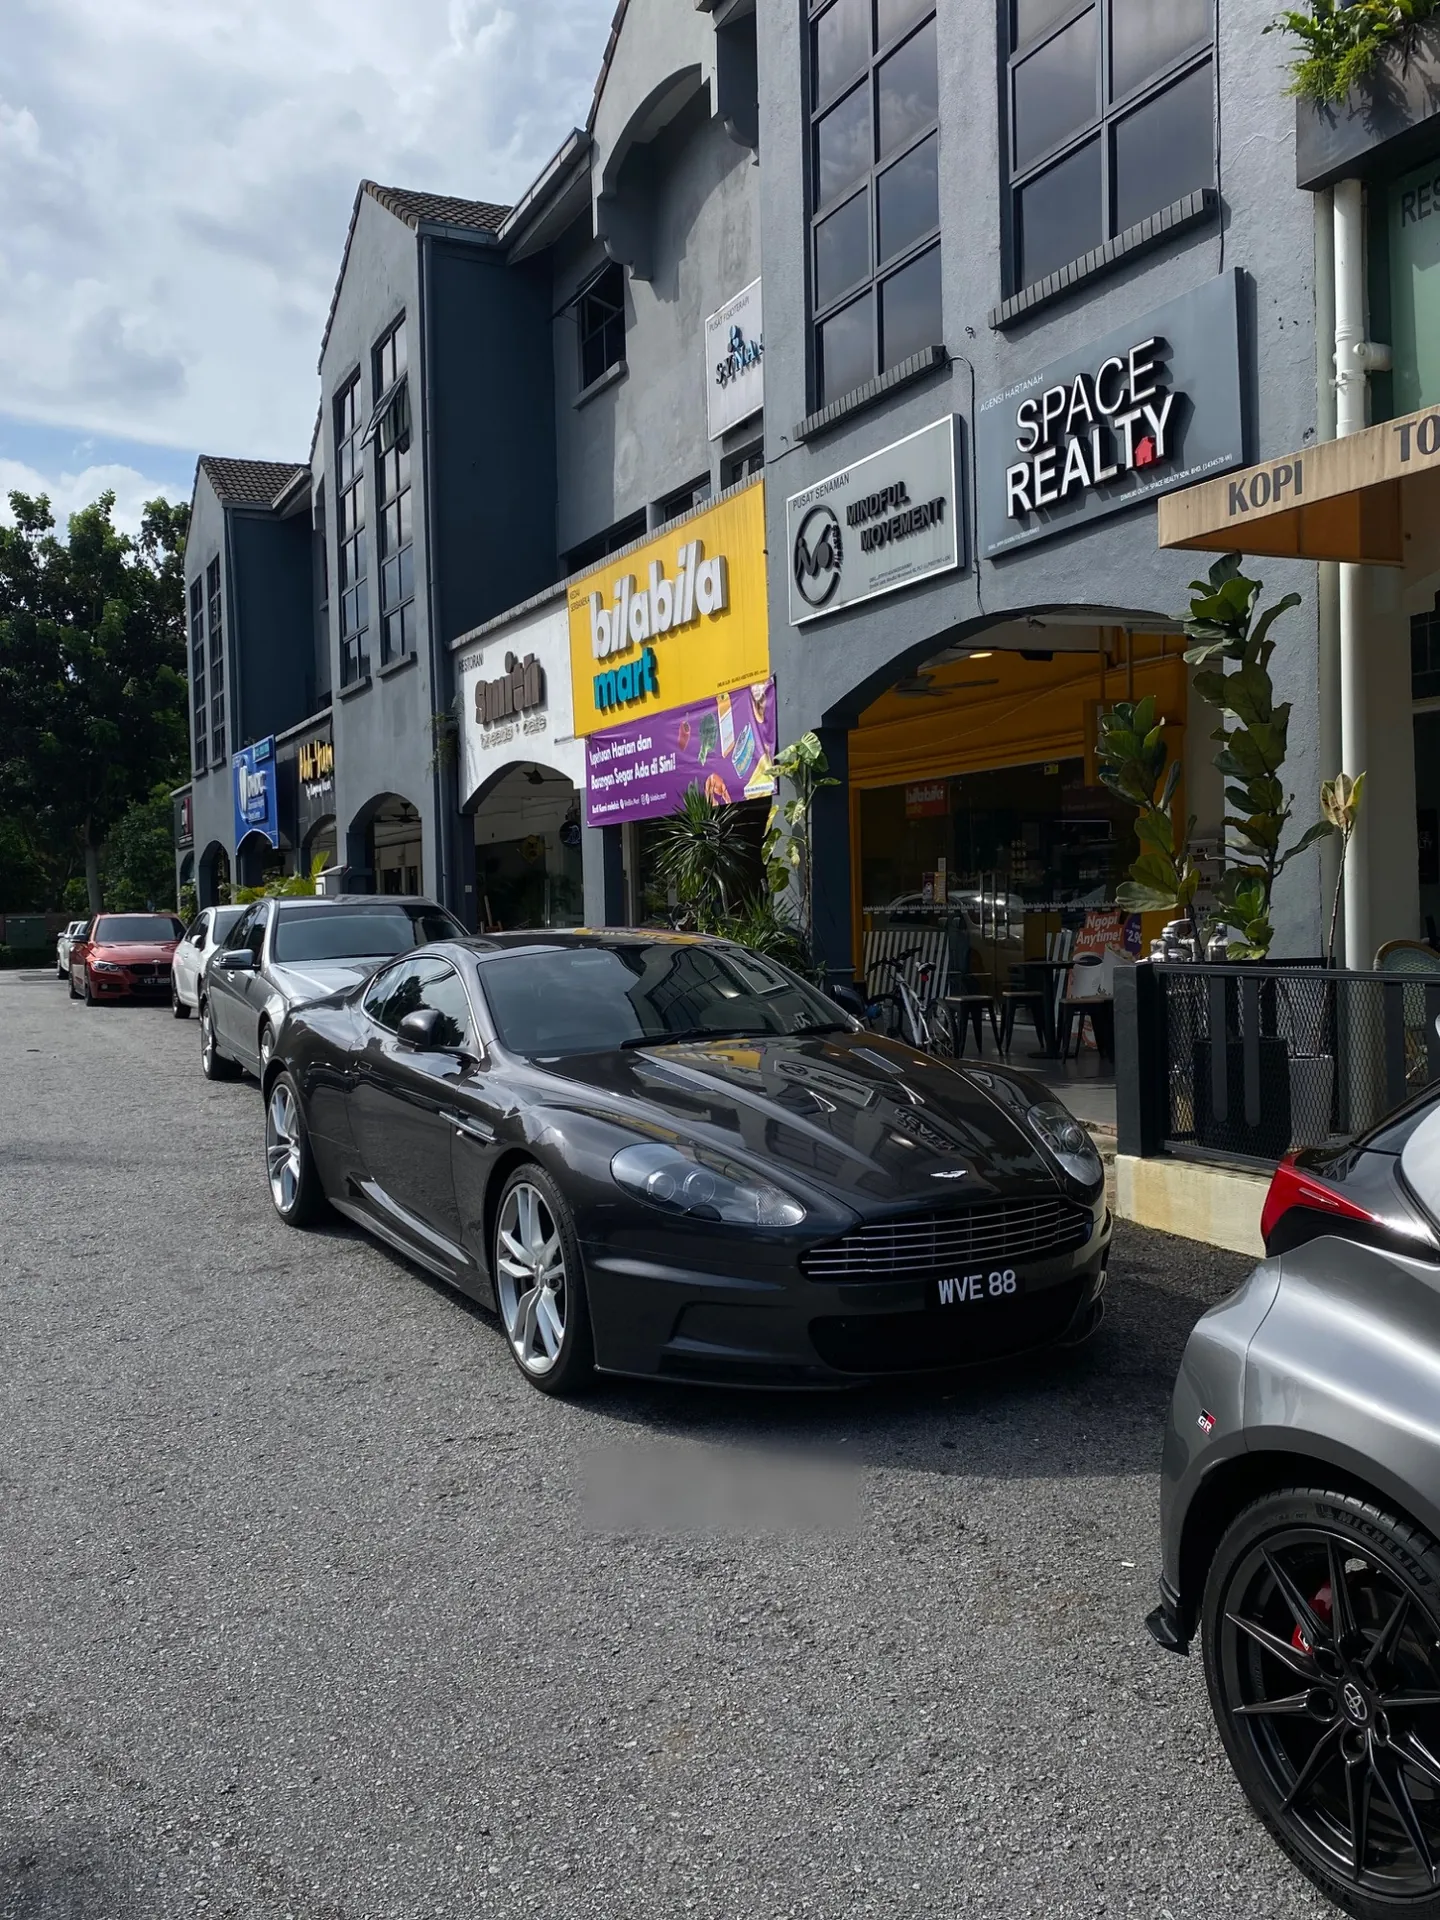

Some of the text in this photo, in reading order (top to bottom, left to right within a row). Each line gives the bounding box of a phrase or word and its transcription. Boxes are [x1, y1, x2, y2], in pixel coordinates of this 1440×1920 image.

[715, 333, 764, 385] SYNA
[980, 373, 1044, 414] AGENSI HARTANAH
[1015, 336, 1158, 453] SPACE
[1005, 392, 1175, 518] REALTY
[1228, 413, 1440, 517] KOPI TO
[792, 472, 850, 512] PUSAT SENAMAN
[846, 480, 908, 526] MINDFUL
[1150, 479, 1164, 491] SPACE
[1163, 474, 1180, 486] REALTY
[860, 496, 946, 552] MOVEMENT
[589, 538, 728, 660] bilabila
[475, 650, 541, 726] smith
[593, 646, 655, 710] mart
[611, 738, 637, 759] Harian
[637, 734, 652, 751] dan
[613, 767, 634, 787] Segar
[634, 760, 651, 780] Ada
[650, 757, 659, 776] di
[659, 752, 677, 774] Sini!
[1076, 928, 1123, 948] Anytime!
[1086, 912, 1119, 931] Ngopi
[938, 1269, 1017, 1305] WVE 88
[1198, 1415, 1212, 1433] GR
[1337, 1510, 1427, 1580] MICHELIN
